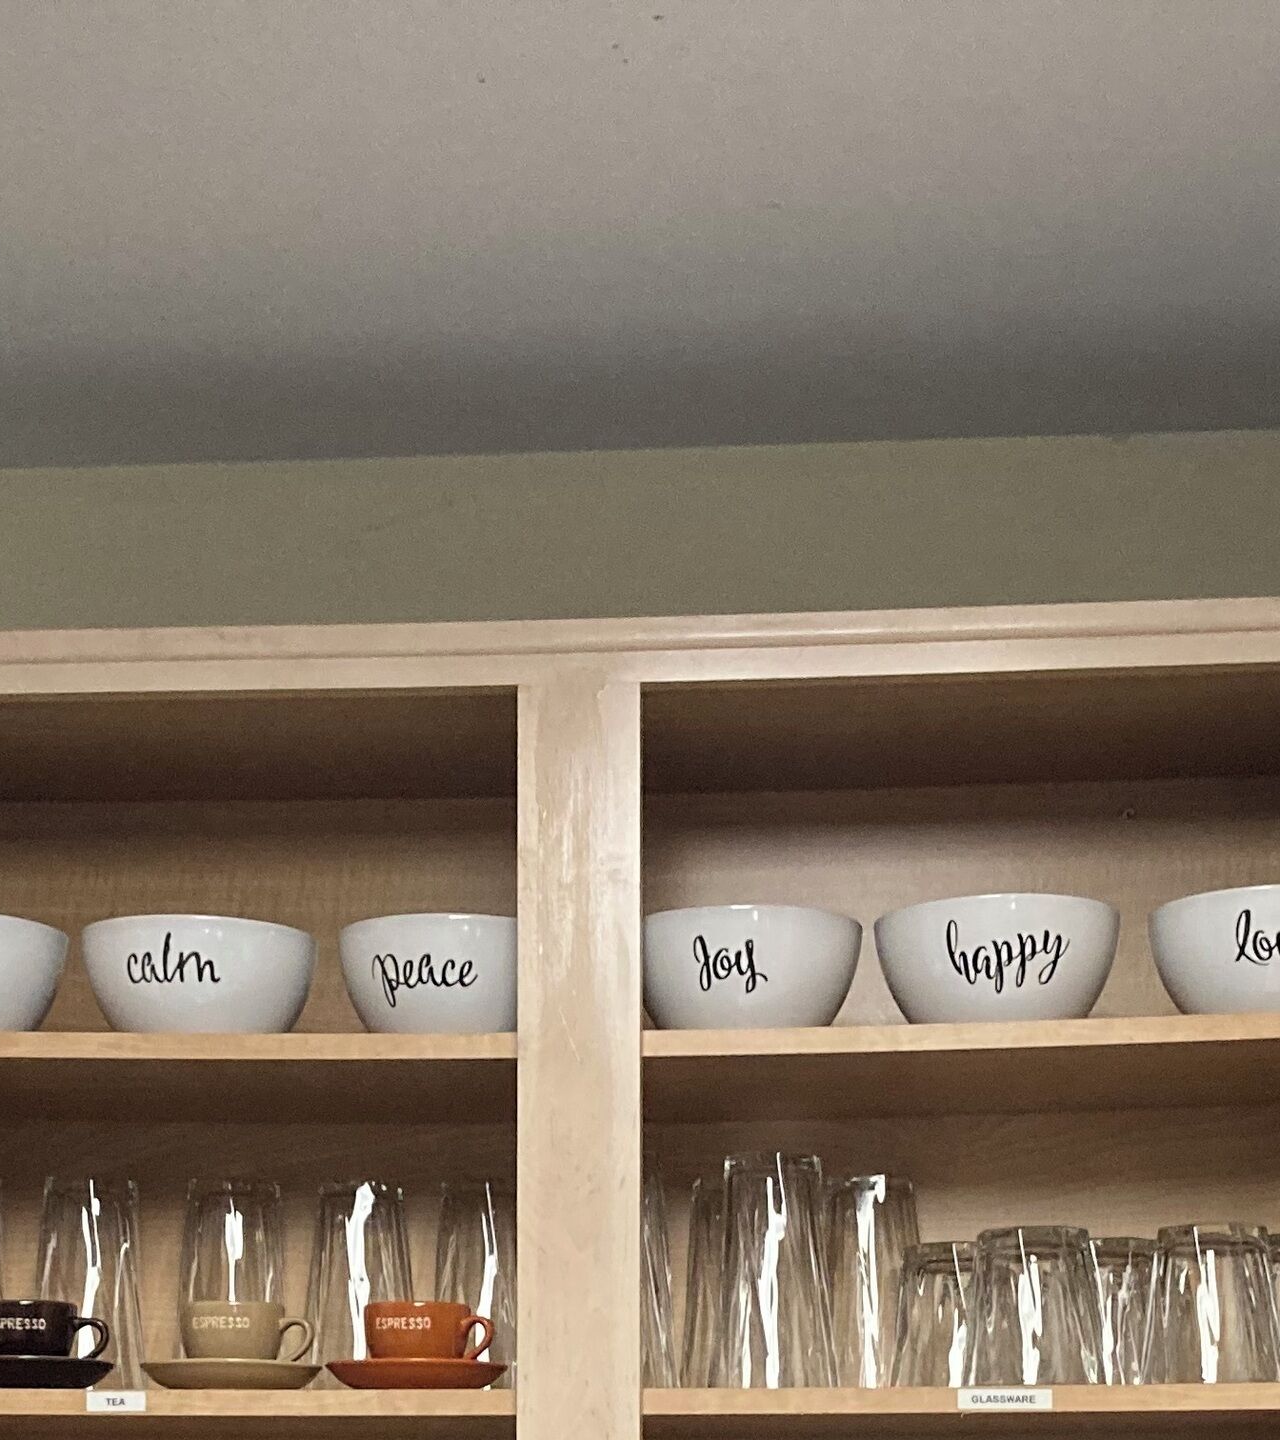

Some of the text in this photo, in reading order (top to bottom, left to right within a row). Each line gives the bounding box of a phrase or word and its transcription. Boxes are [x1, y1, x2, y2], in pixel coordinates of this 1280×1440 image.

[126, 932, 222, 985] calm
[946, 919, 1070, 994] happy
[371, 952, 480, 1008] peace
[192, 1316, 251, 1329] ESPRESSO
[375, 1316, 432, 1330] ESPRESSO
[105, 1397, 126, 1406] TEA
[971, 1394, 1037, 1404] GLASSWARE
